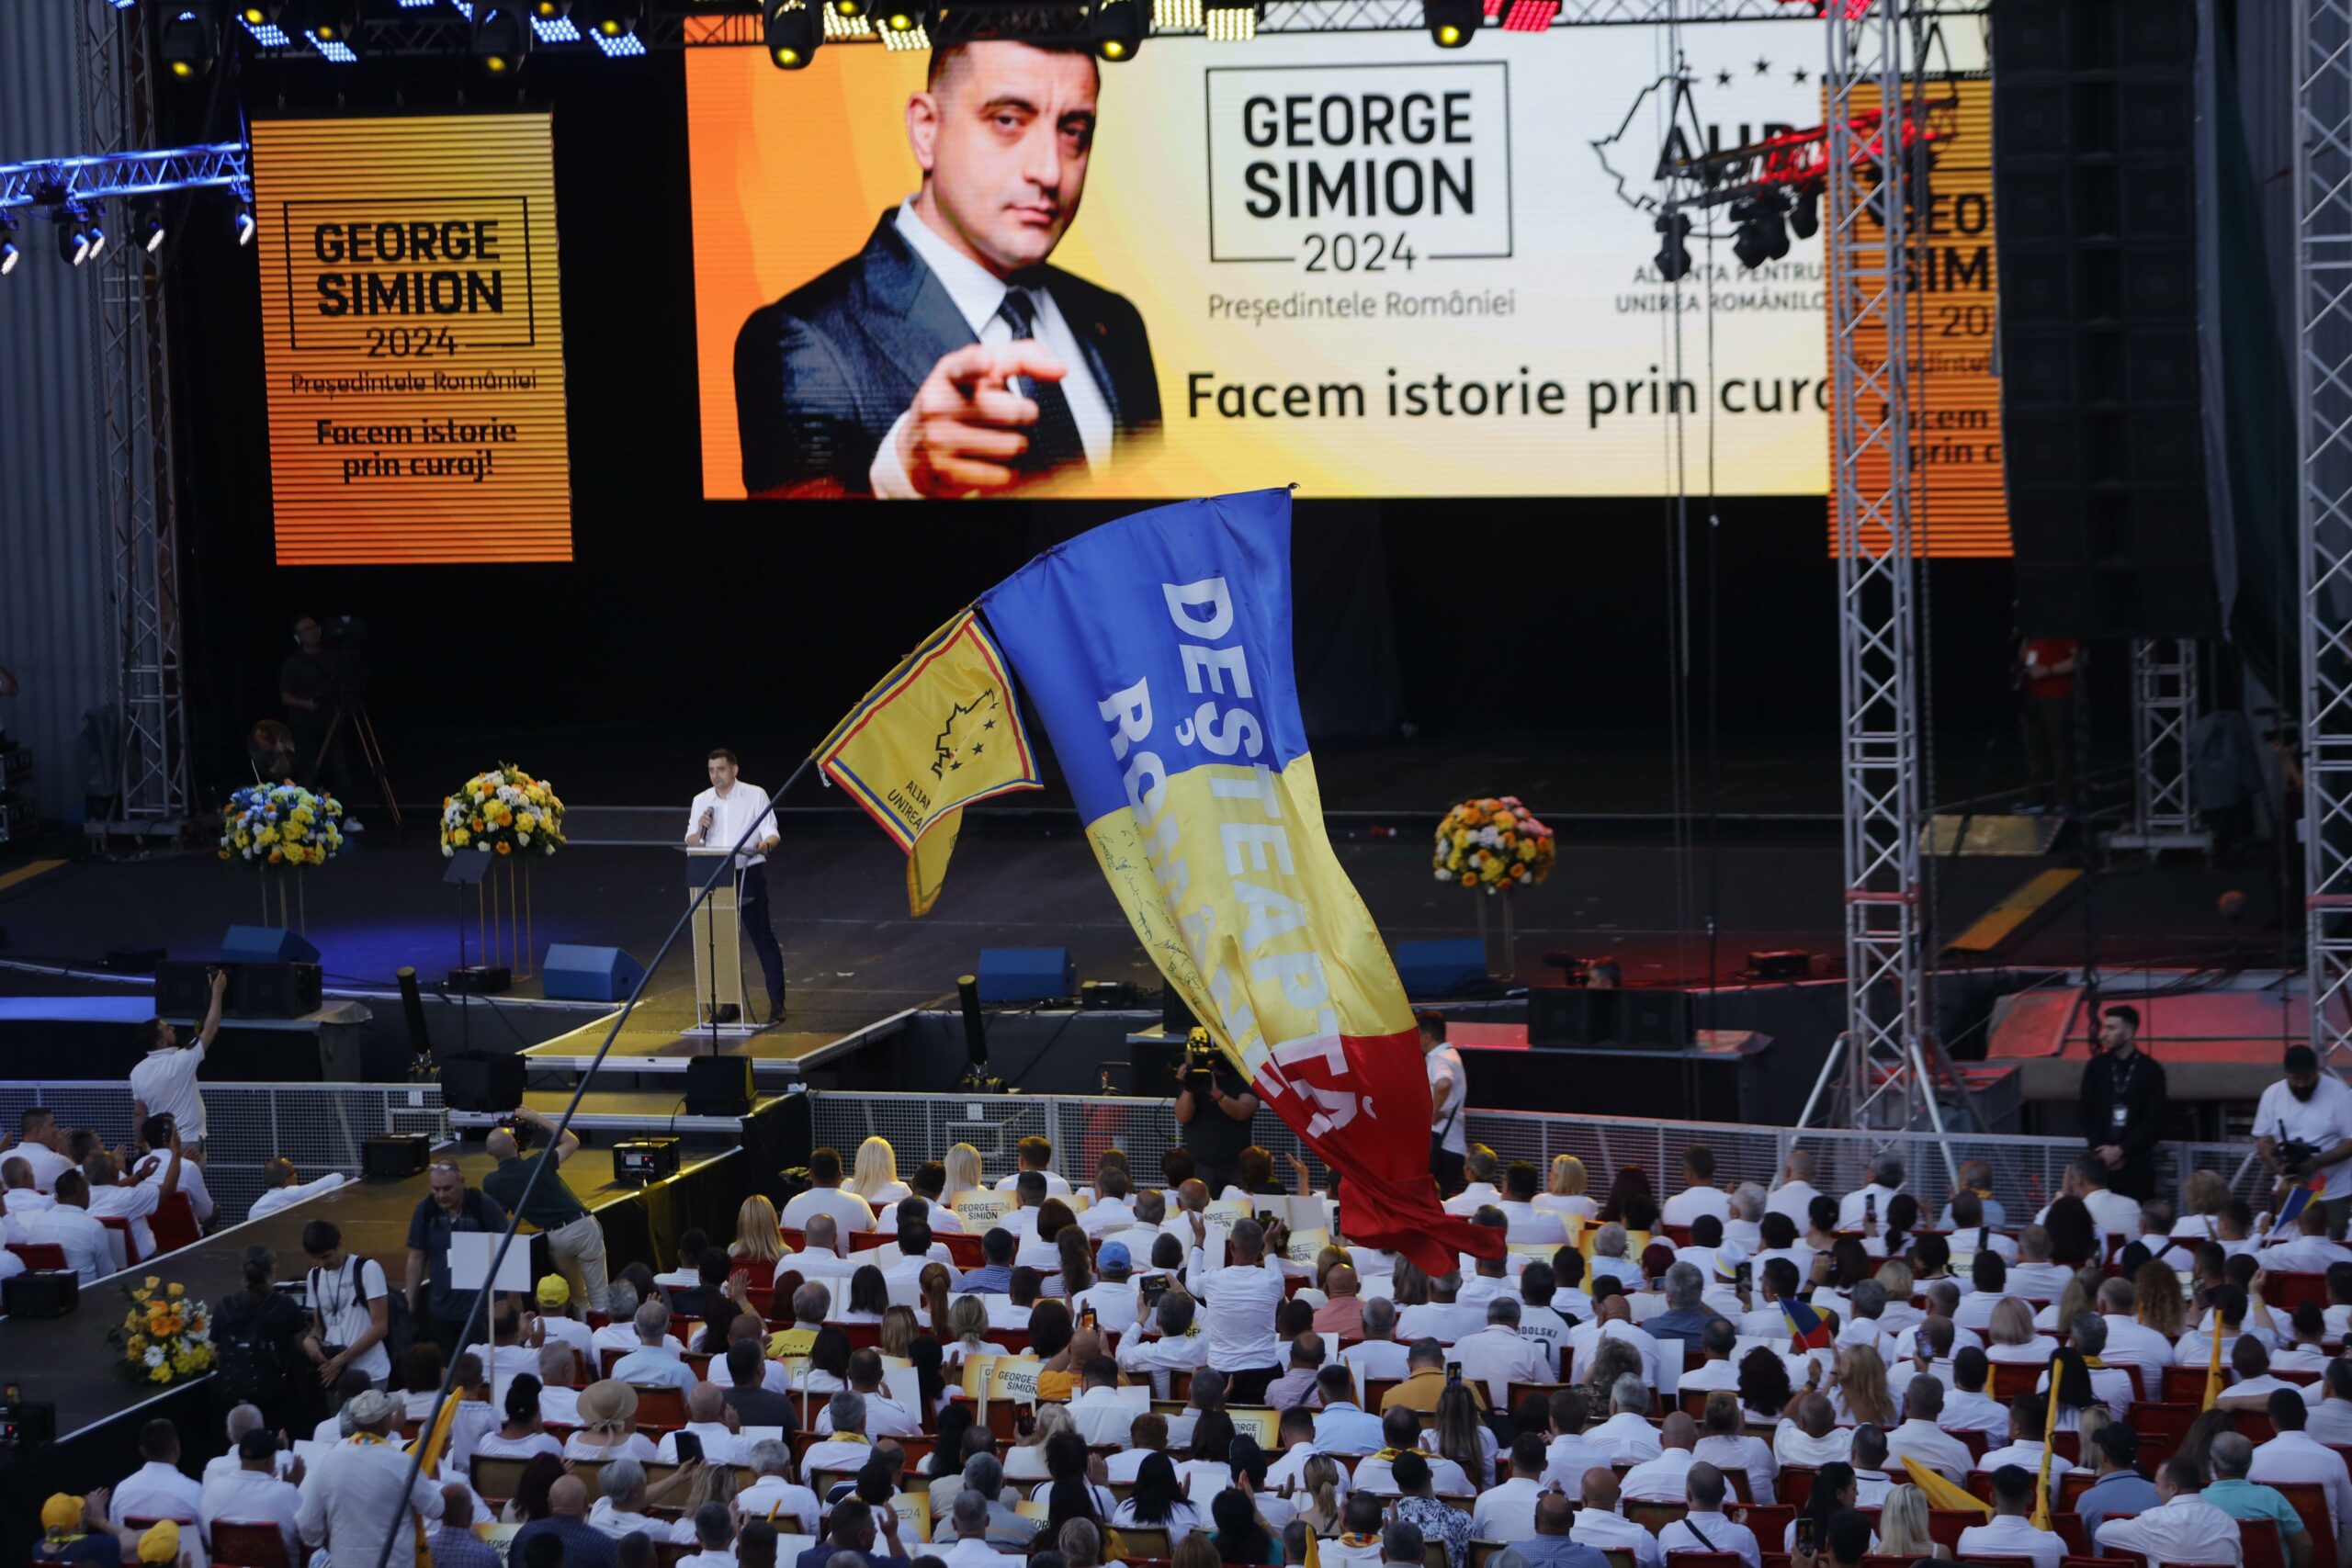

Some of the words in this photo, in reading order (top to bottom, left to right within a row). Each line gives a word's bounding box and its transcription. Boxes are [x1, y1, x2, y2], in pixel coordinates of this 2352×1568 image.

[1243, 91, 1473, 147] GEORGE
[1245, 157, 1474, 219] SIMION
[314, 219, 500, 264] GEORGE
[1304, 231, 1417, 272] 2024
[317, 269, 503, 317] SIMION
[1208, 290, 1376, 325] Președintele
[1386, 288, 1516, 318] României
[1939, 306, 1988, 337] 20
[367, 326, 457, 358] 2024
[290, 372, 425, 400] Președintele
[433, 368, 537, 391] României
[1187, 372, 1365, 418] Facem
[1385, 367, 1566, 416] istorie
[1589, 366, 1697, 428] prin
[316, 418, 413, 445] Facem
[423, 416, 517, 444] istorie
[343, 451, 401, 484] prin
[410, 449, 493, 483] curaj!
[887, 787, 922, 830] UNIREA
[957, 1202, 990, 1213] GEORGE
[967, 1211, 998, 1220] SIMION
[998, 1370, 1033, 1384] GEORGE
[1007, 1381, 1037, 1394] SIMION
